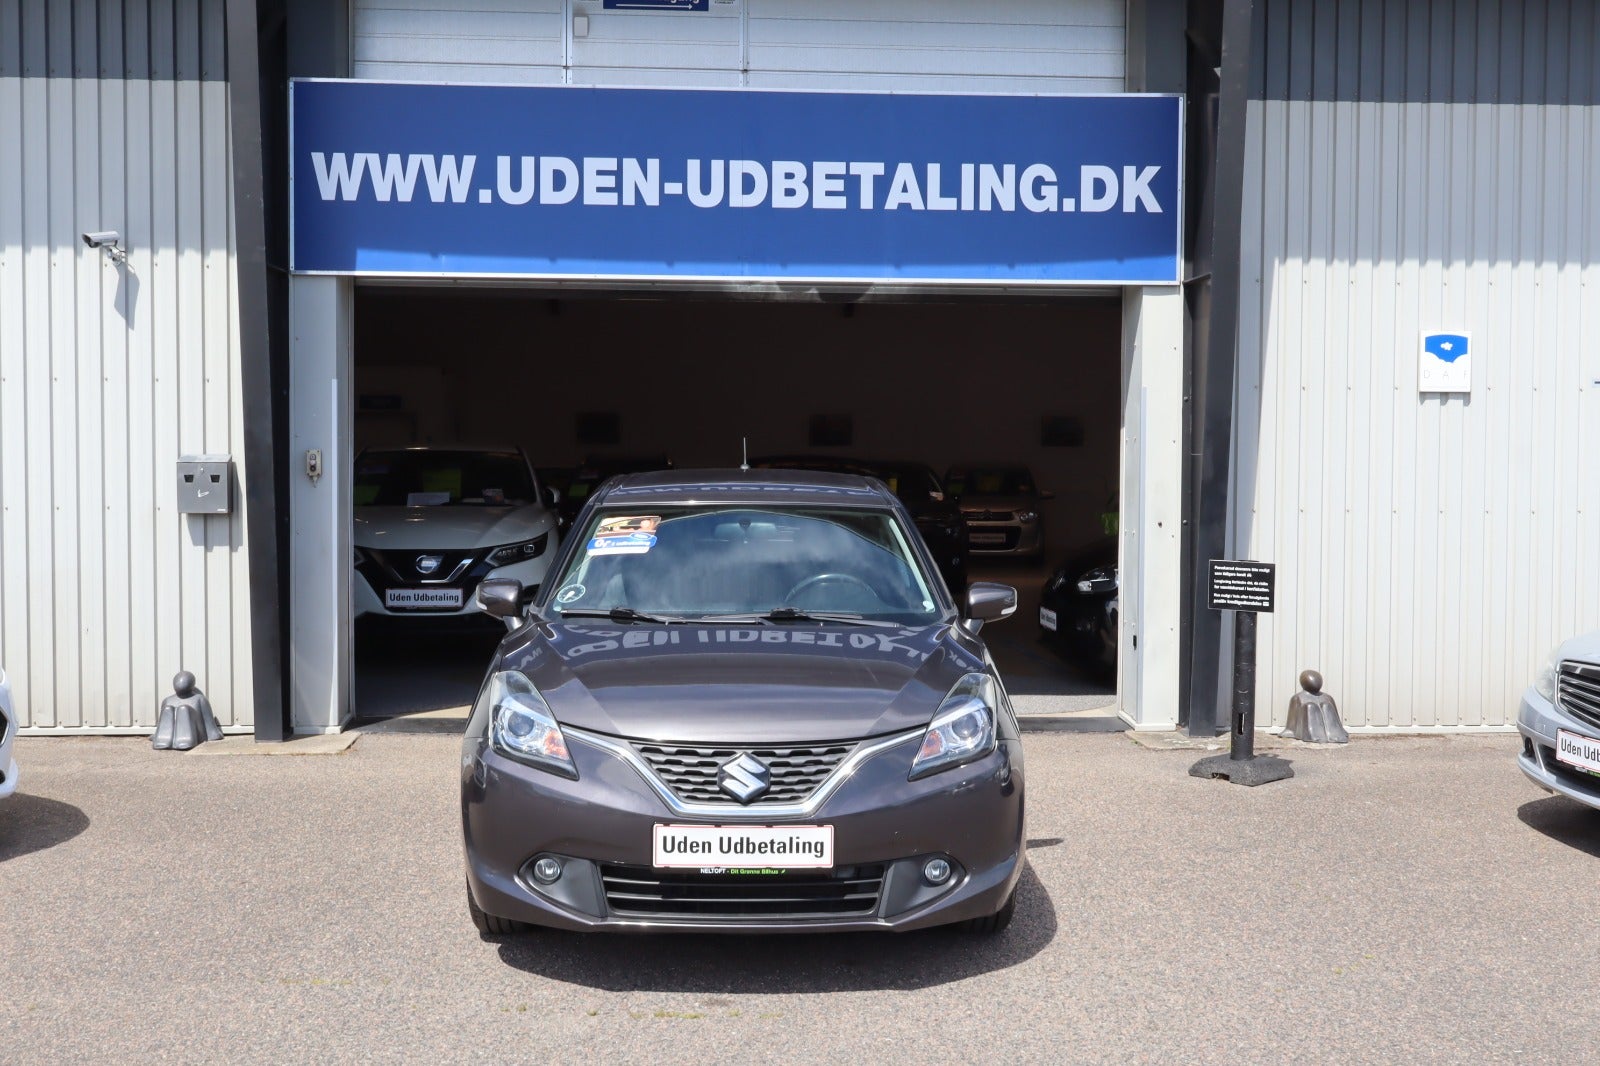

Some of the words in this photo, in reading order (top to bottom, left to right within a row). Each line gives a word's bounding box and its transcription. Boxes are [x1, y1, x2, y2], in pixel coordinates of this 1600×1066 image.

[311, 152, 1164, 213] WWW.UDEN-UDBETALING.DK
[389, 593, 411, 602] Uden
[413, 593, 459, 603] Udbetaling
[1561, 738, 1582, 757] Uden
[662, 835, 712, 854] Uden
[719, 836, 825, 858] Udbetaling
